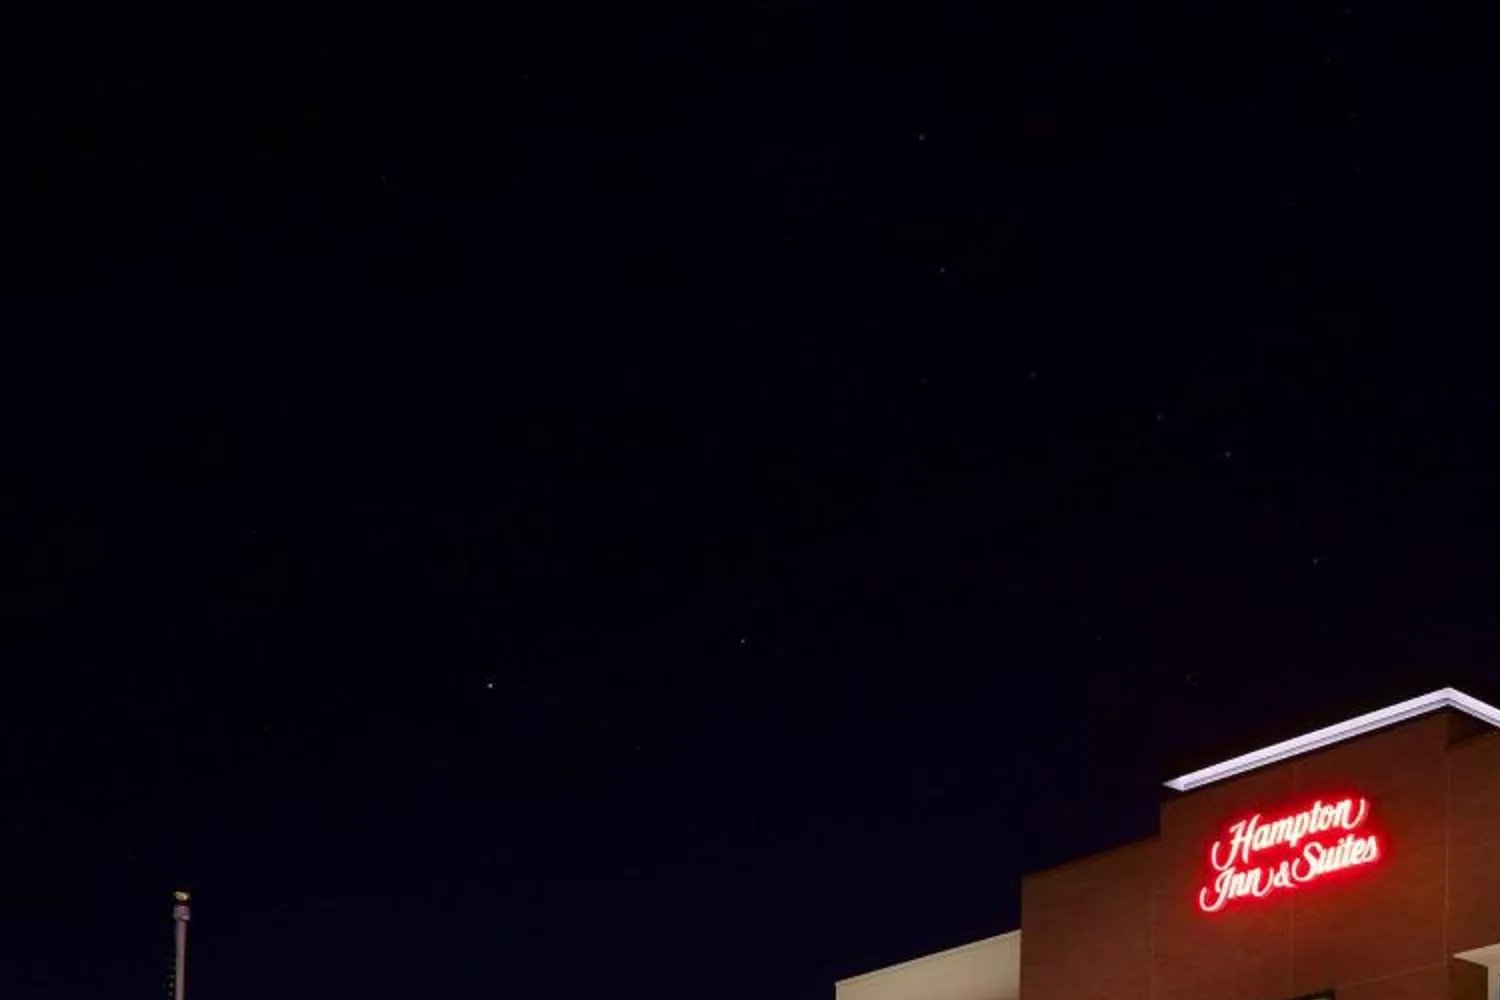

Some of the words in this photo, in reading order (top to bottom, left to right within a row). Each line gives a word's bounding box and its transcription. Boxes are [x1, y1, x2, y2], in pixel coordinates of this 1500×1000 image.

[1211, 797, 1367, 871] Hampton
[1199, 866, 1275, 912] Inn
[1273, 860, 1295, 888] &
[1291, 833, 1379, 881] Suites
